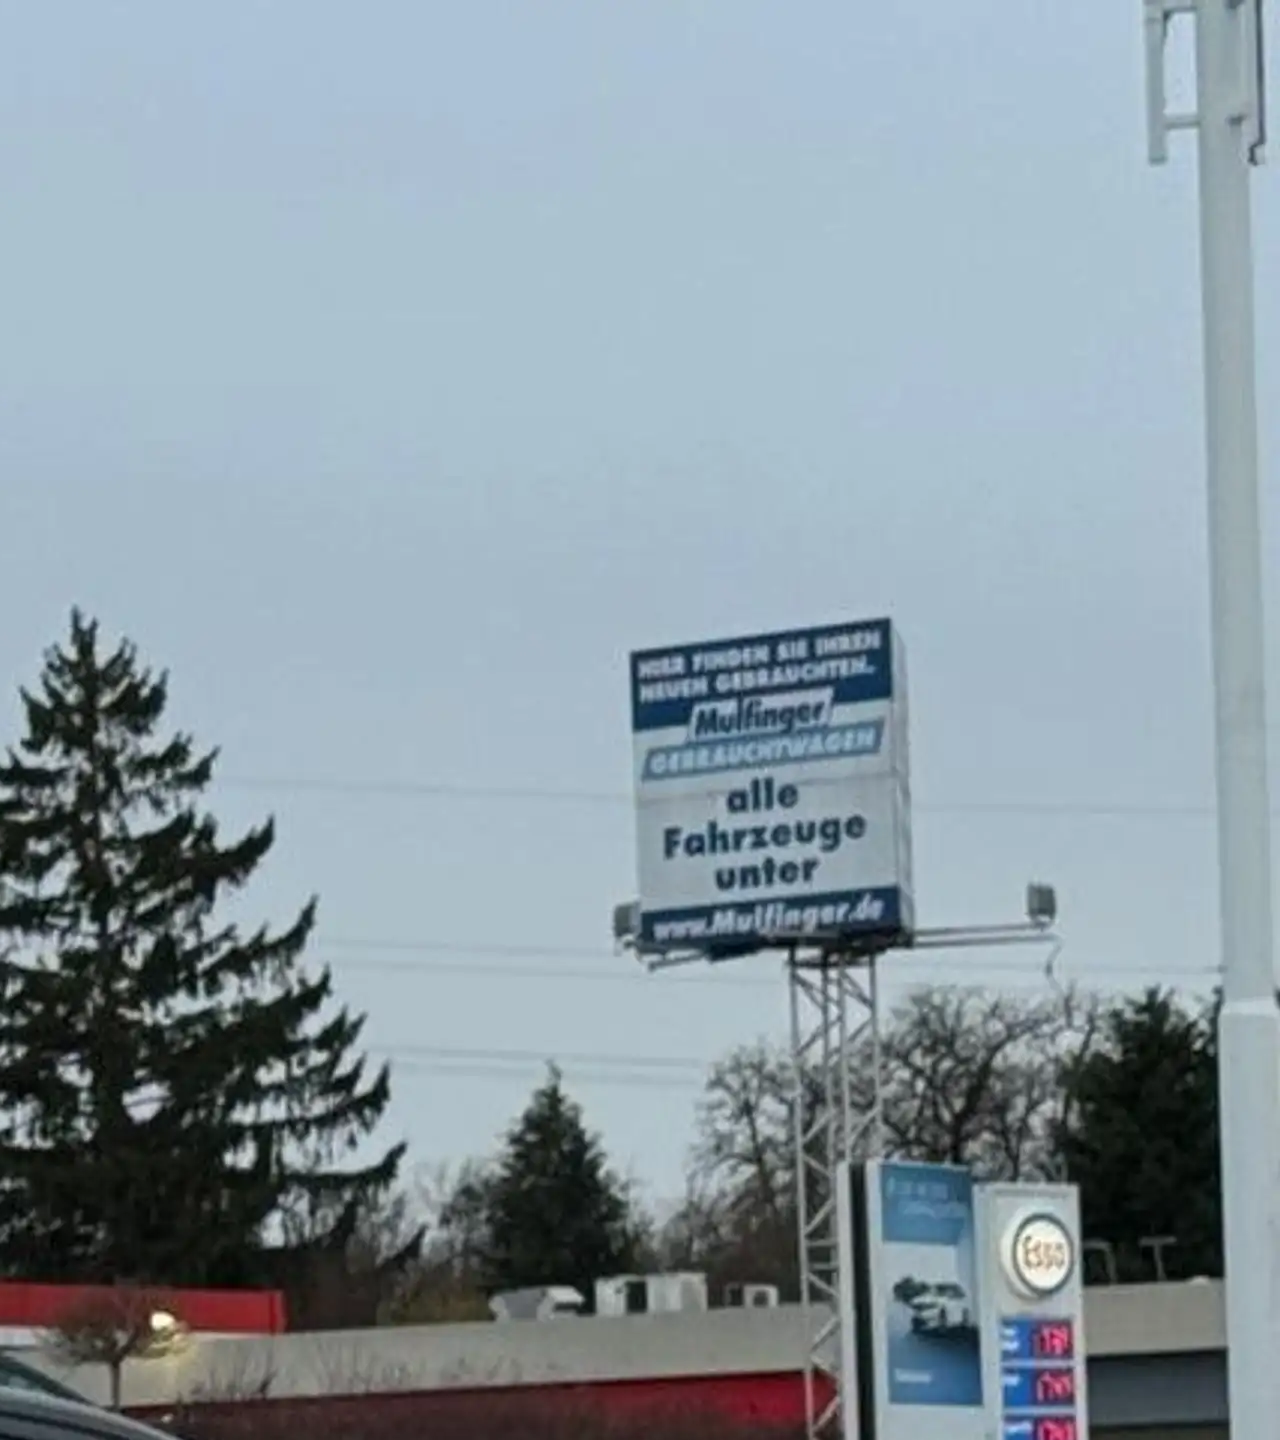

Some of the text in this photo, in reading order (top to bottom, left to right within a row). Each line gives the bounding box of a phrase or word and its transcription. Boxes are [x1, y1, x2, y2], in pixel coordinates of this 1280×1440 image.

[636, 628, 882, 679] HIER FINDEN SIE IHREN
[640, 676, 709, 704] NEUEN
[695, 695, 825, 737] Mulfinger
[650, 727, 877, 774] GEBRAUCHTWAGEN
[726, 777, 799, 813] alle
[663, 814, 868, 860] Fahrzeuge
[715, 856, 821, 890] unter
[653, 893, 886, 942] www.Mulfinger.de
